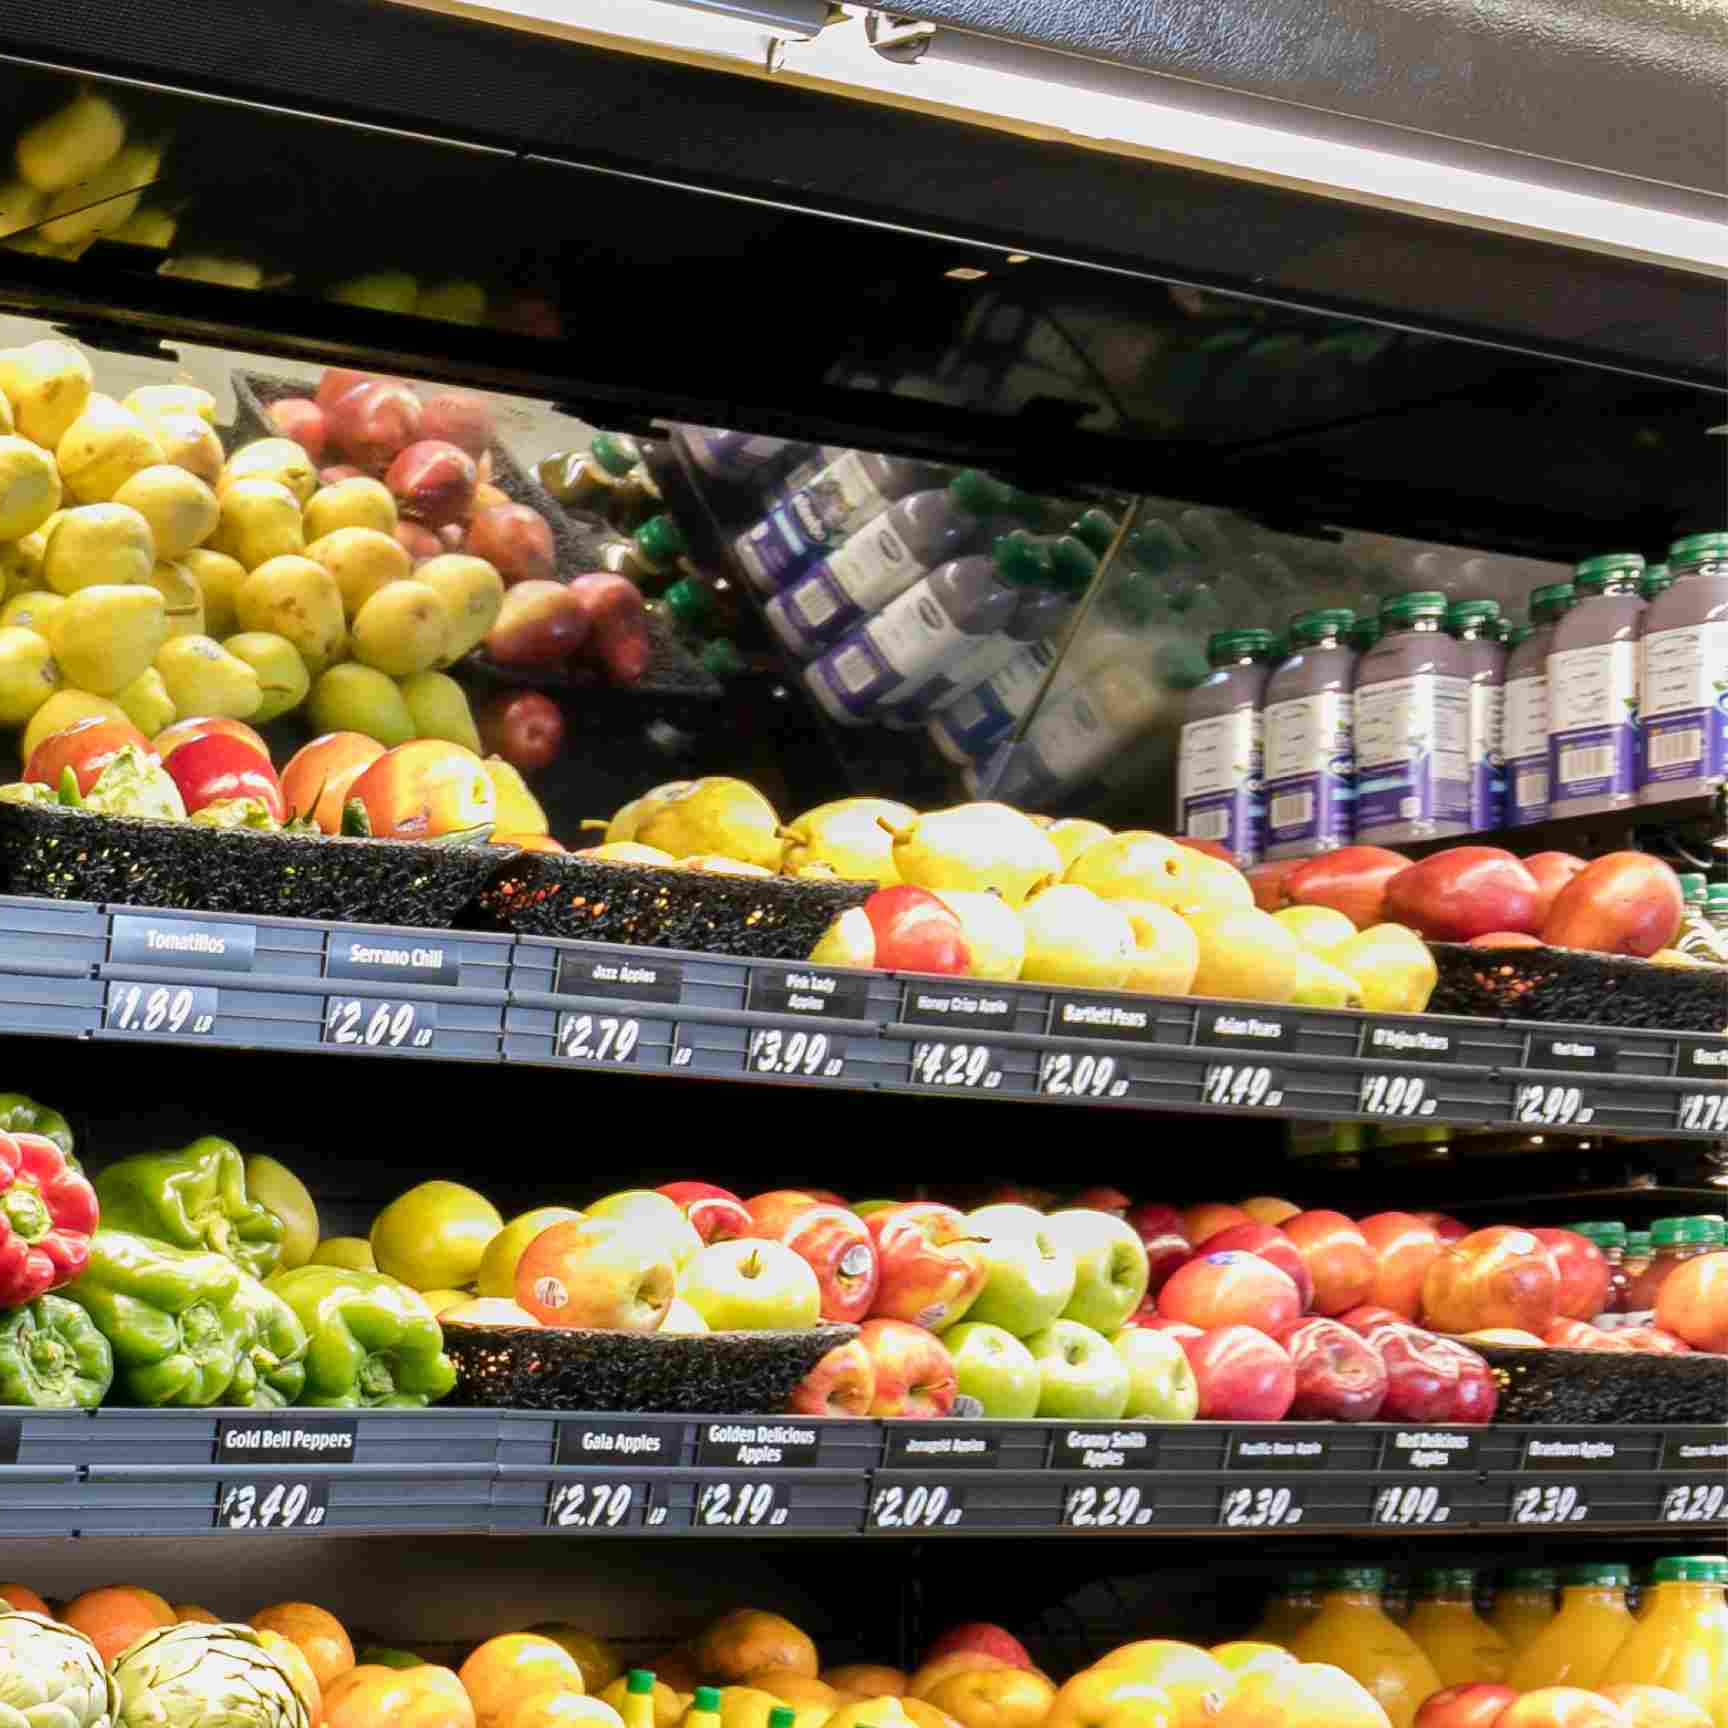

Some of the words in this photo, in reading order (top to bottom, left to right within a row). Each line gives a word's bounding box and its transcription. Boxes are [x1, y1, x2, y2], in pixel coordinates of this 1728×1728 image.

[142, 928, 229, 953] Tomatillos
[345, 944, 410, 966] Serrano
[111, 984, 194, 1032] $1.89
[1064, 1004, 1114, 1024] Bartlett
[1112, 1008, 1146, 1027] Pears
[226, 1430, 261, 1448] Gold
[262, 1430, 291, 1448] Bell
[292, 1430, 352, 1450] Peppers
[614, 1434, 660, 1453] Apples
[709, 1425, 756, 1443] Golden
[737, 1445, 781, 1464] Apples
[223, 1484, 307, 1529] $3.49
